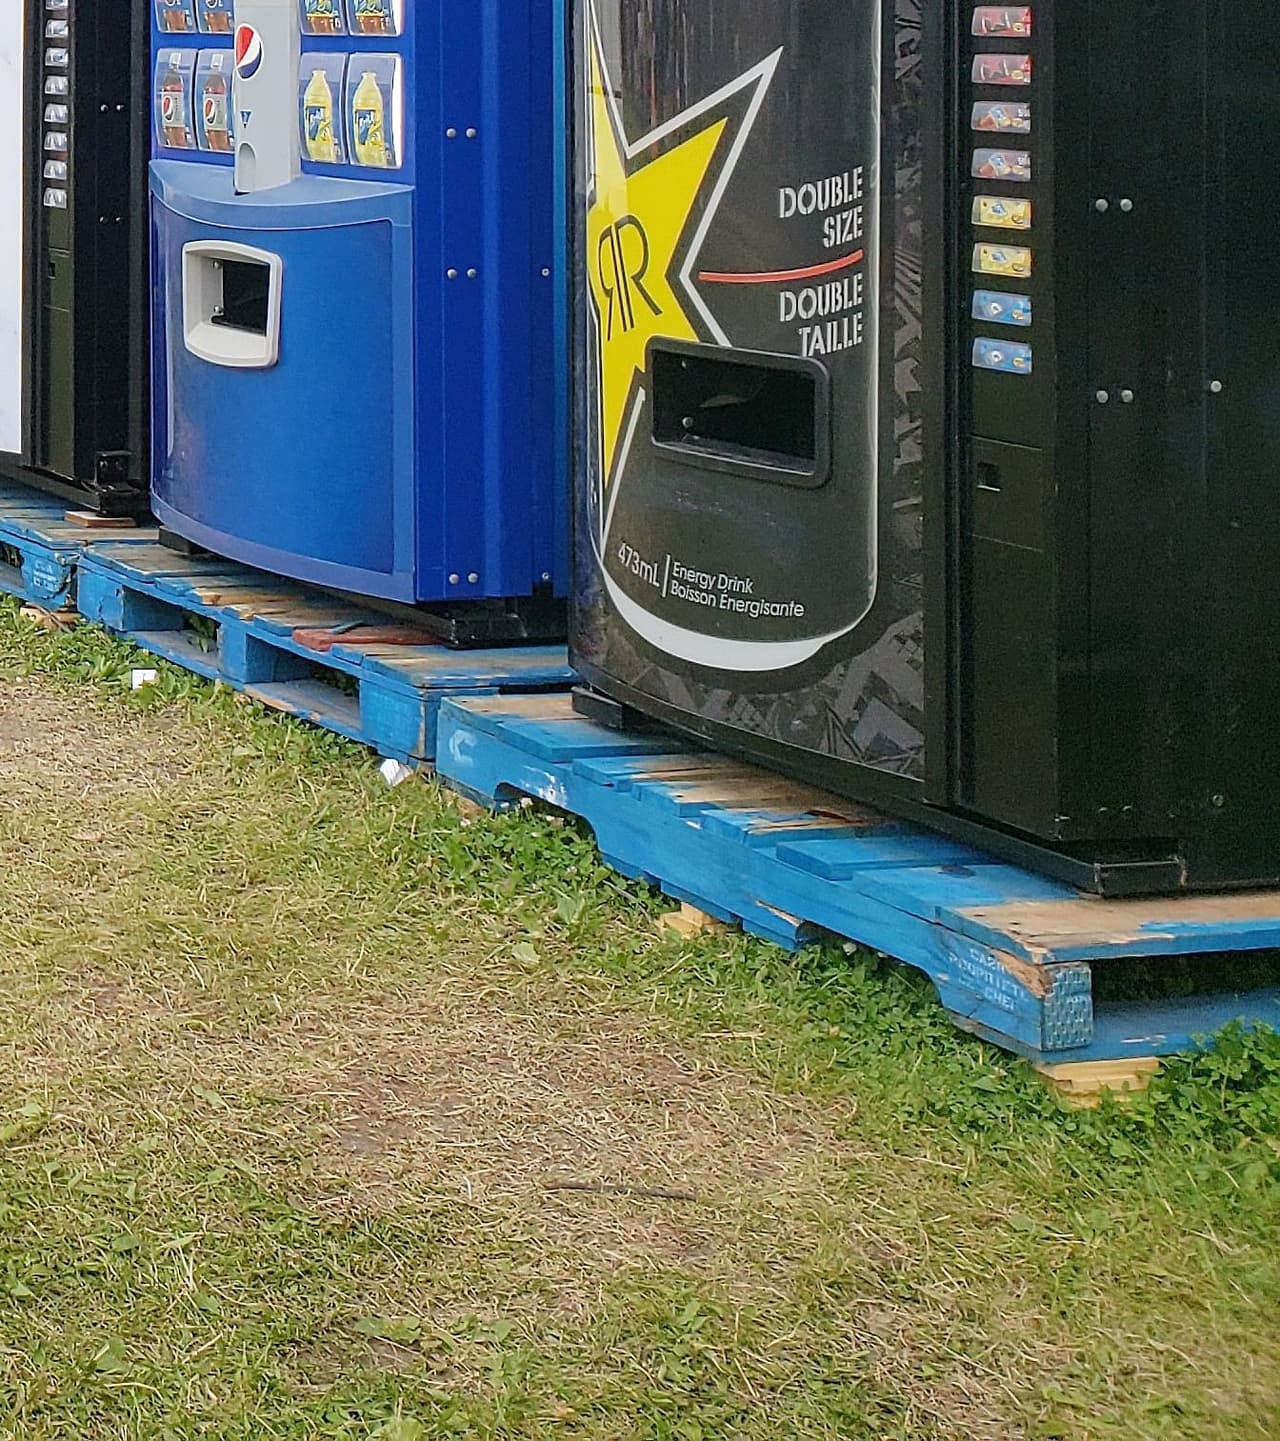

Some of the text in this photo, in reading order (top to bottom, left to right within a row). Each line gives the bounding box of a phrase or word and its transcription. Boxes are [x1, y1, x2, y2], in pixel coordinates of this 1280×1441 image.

[779, 166, 863, 218] DOUBLE
[823, 205, 864, 249] SIZE
[779, 272, 863, 322] DOUBLE
[798, 311, 863, 358] TAILLE
[618, 543, 754, 594] 473mL Energy Drink
[670, 580, 806, 619] Boisson Énergisante
